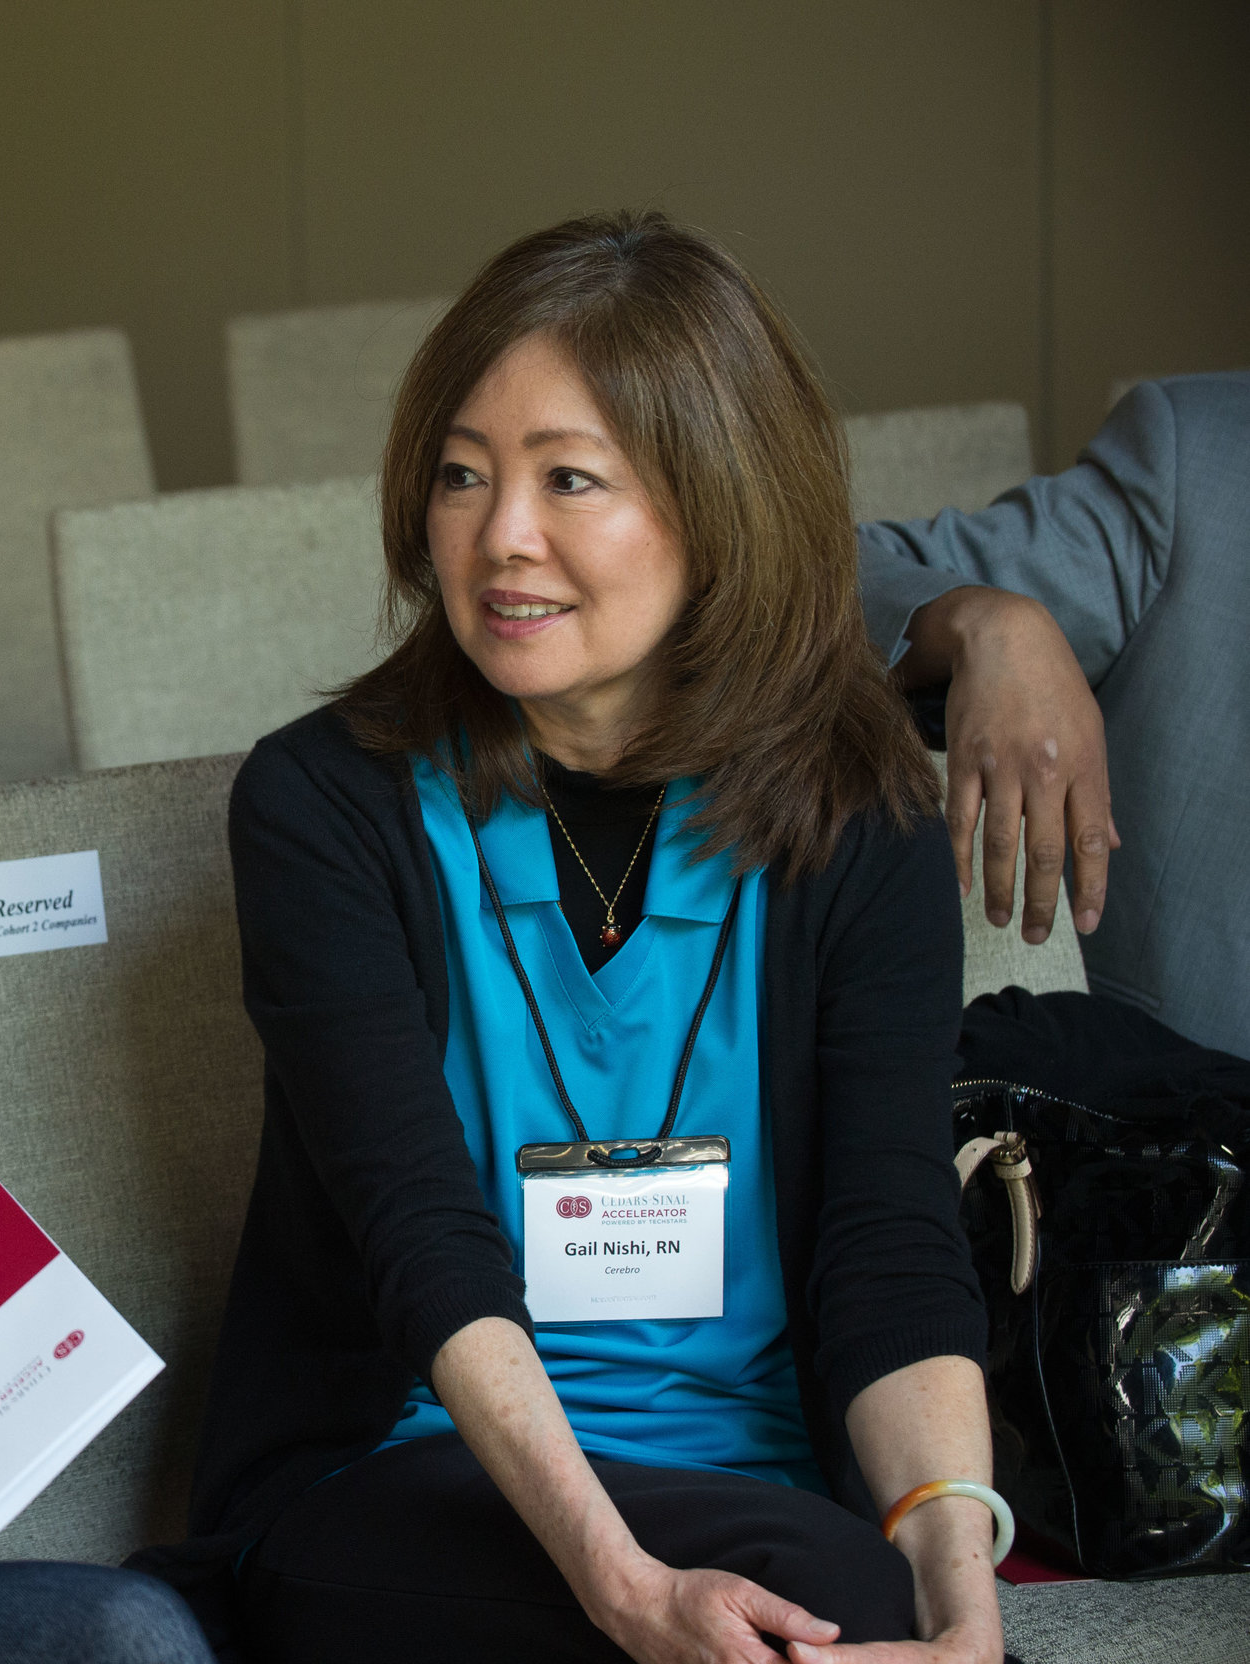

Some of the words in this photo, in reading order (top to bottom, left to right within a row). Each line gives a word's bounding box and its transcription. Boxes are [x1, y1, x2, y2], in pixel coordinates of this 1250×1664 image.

[31, 921, 38, 932] 2
[41, 914, 98, 931] Companies
[602, 1208, 687, 1218] ACCELERATOR
[565, 1241, 597, 1256] Gail
[603, 1241, 650, 1257] Nishi,
[656, 1240, 680, 1254] RN
[604, 1266, 640, 1274] Cerebro
